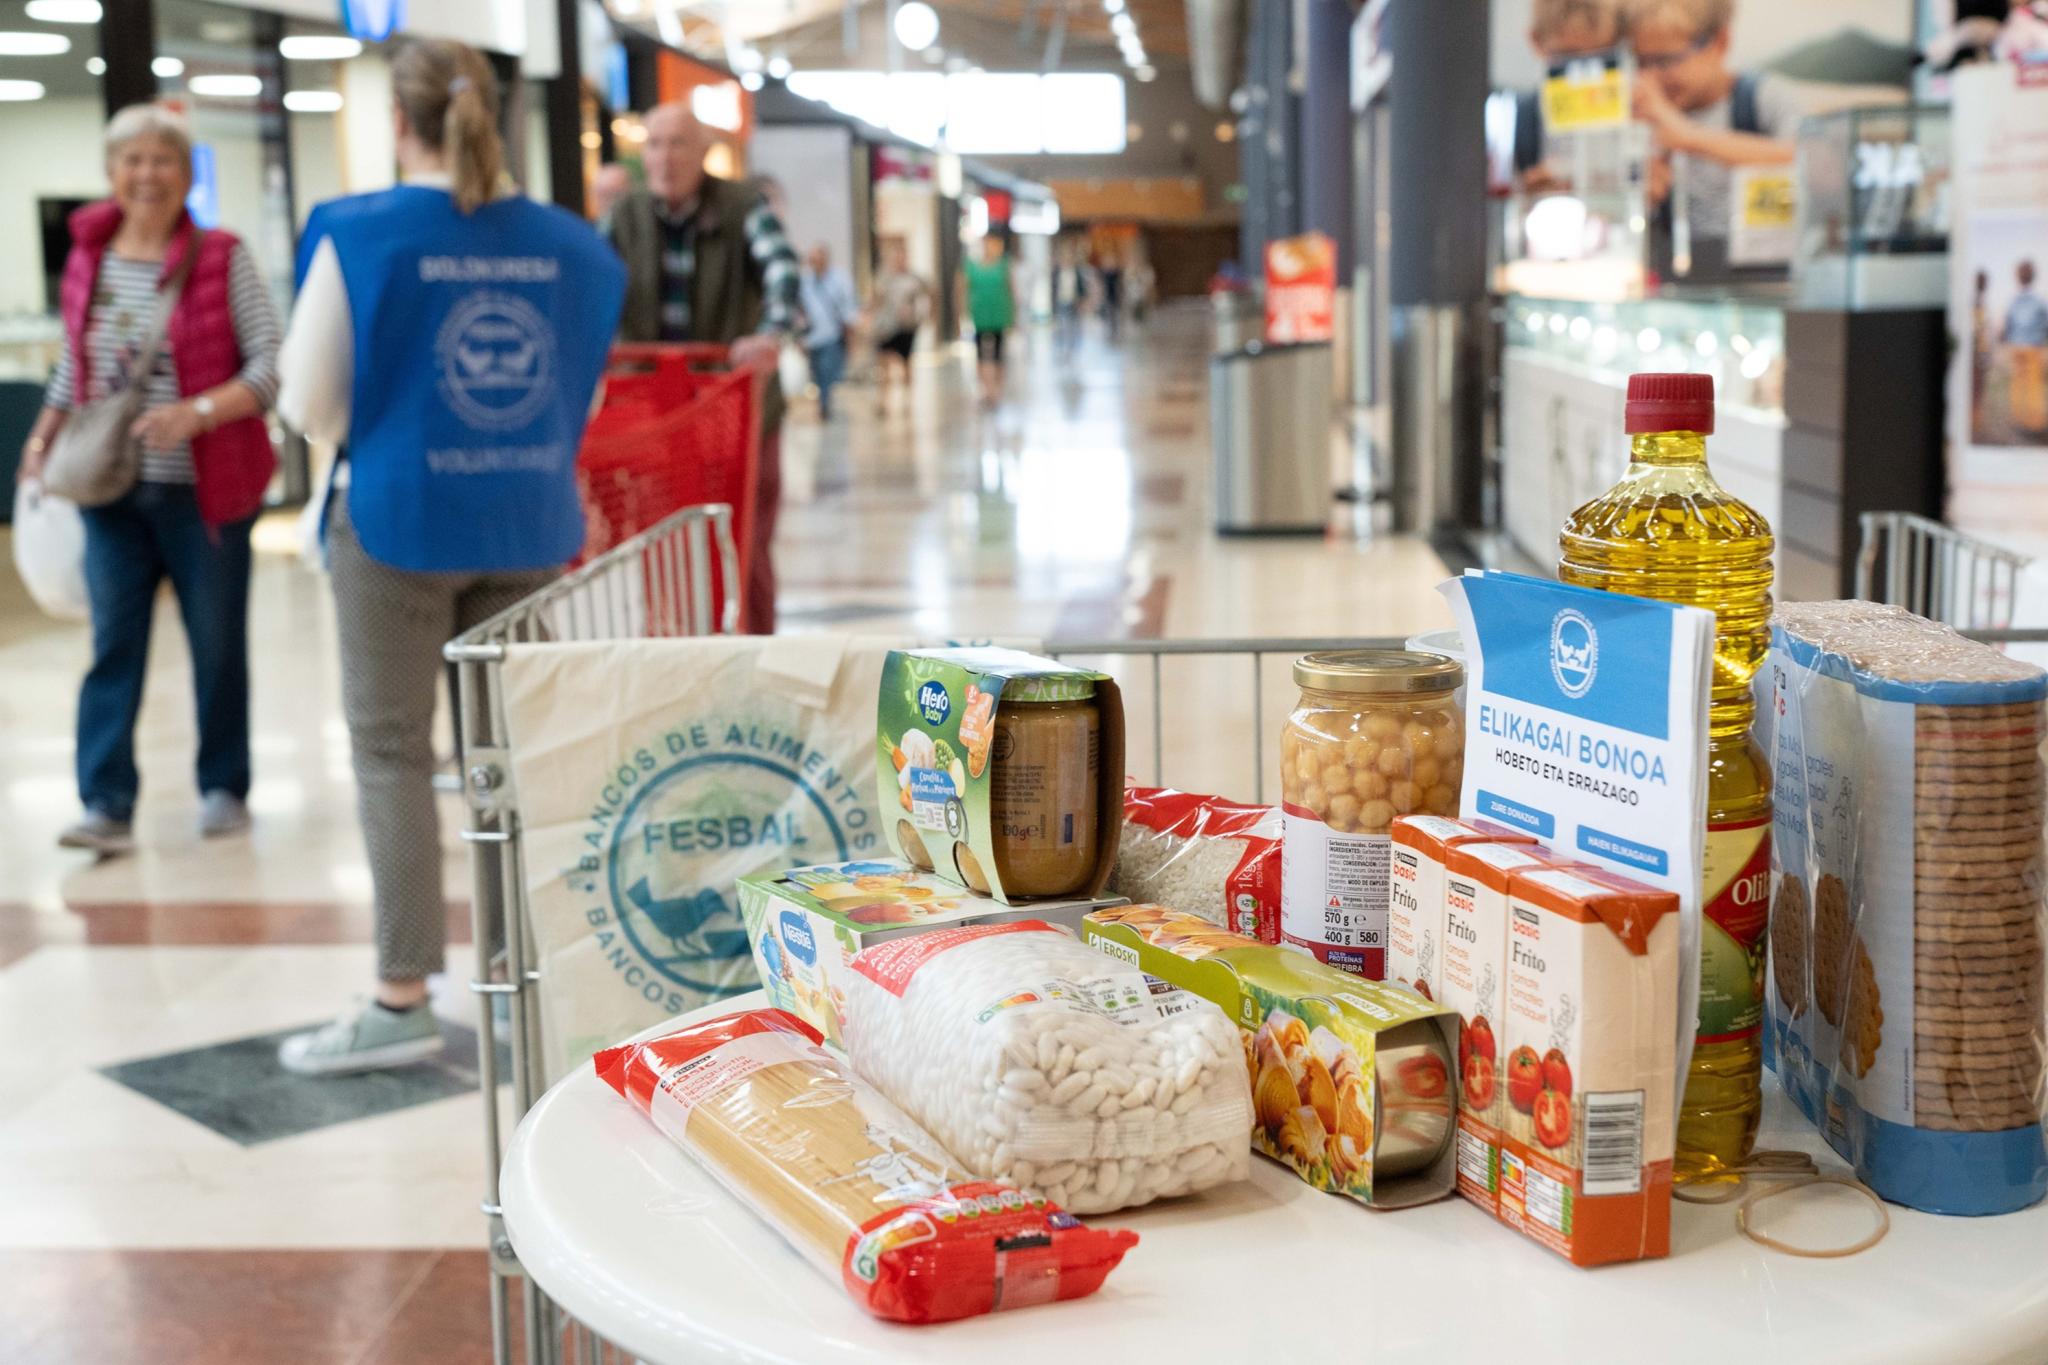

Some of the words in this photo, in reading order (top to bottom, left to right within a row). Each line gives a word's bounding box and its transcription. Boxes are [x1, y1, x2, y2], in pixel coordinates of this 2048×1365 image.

[920, 686, 948, 711] Hero
[925, 706, 943, 724] Baby
[1479, 704, 1572, 758] ELIKAGAI
[1579, 735, 1668, 786] BONOA
[1495, 747, 1540, 776] HOBETO
[1543, 765, 1565, 784] ETA
[1568, 771, 1640, 807] ERRAZAGO
[579, 749, 656, 871] BANCOS
[665, 725, 709, 756] DE
[724, 723, 876, 850] ALIMENTOS
[1490, 801, 1506, 814] ZURE
[1508, 806, 1540, 826] DONAZIOA
[643, 812, 808, 854] FESBAL
[1587, 836, 1611, 850] HAIEN
[1612, 843, 1659, 866] ELIKAGAIAK
[1393, 863, 1417, 881] basic
[1393, 882, 1418, 911] Frito
[1448, 892, 1474, 913] basic
[1325, 912, 1340, 923] 570
[1343, 915, 1350, 926] g
[1448, 913, 1476, 943] Frito
[1325, 931, 1342, 943] 400
[1345, 934, 1351, 945] g
[1360, 932, 1378, 943] 580
[586, 907, 684, 1014] BANCOS
[1104, 942, 1137, 966] EROSKI
[1513, 941, 1546, 973] Frito
[1342, 964, 1363, 973] FIBRA
[1156, 1006, 1164, 1017] 1
